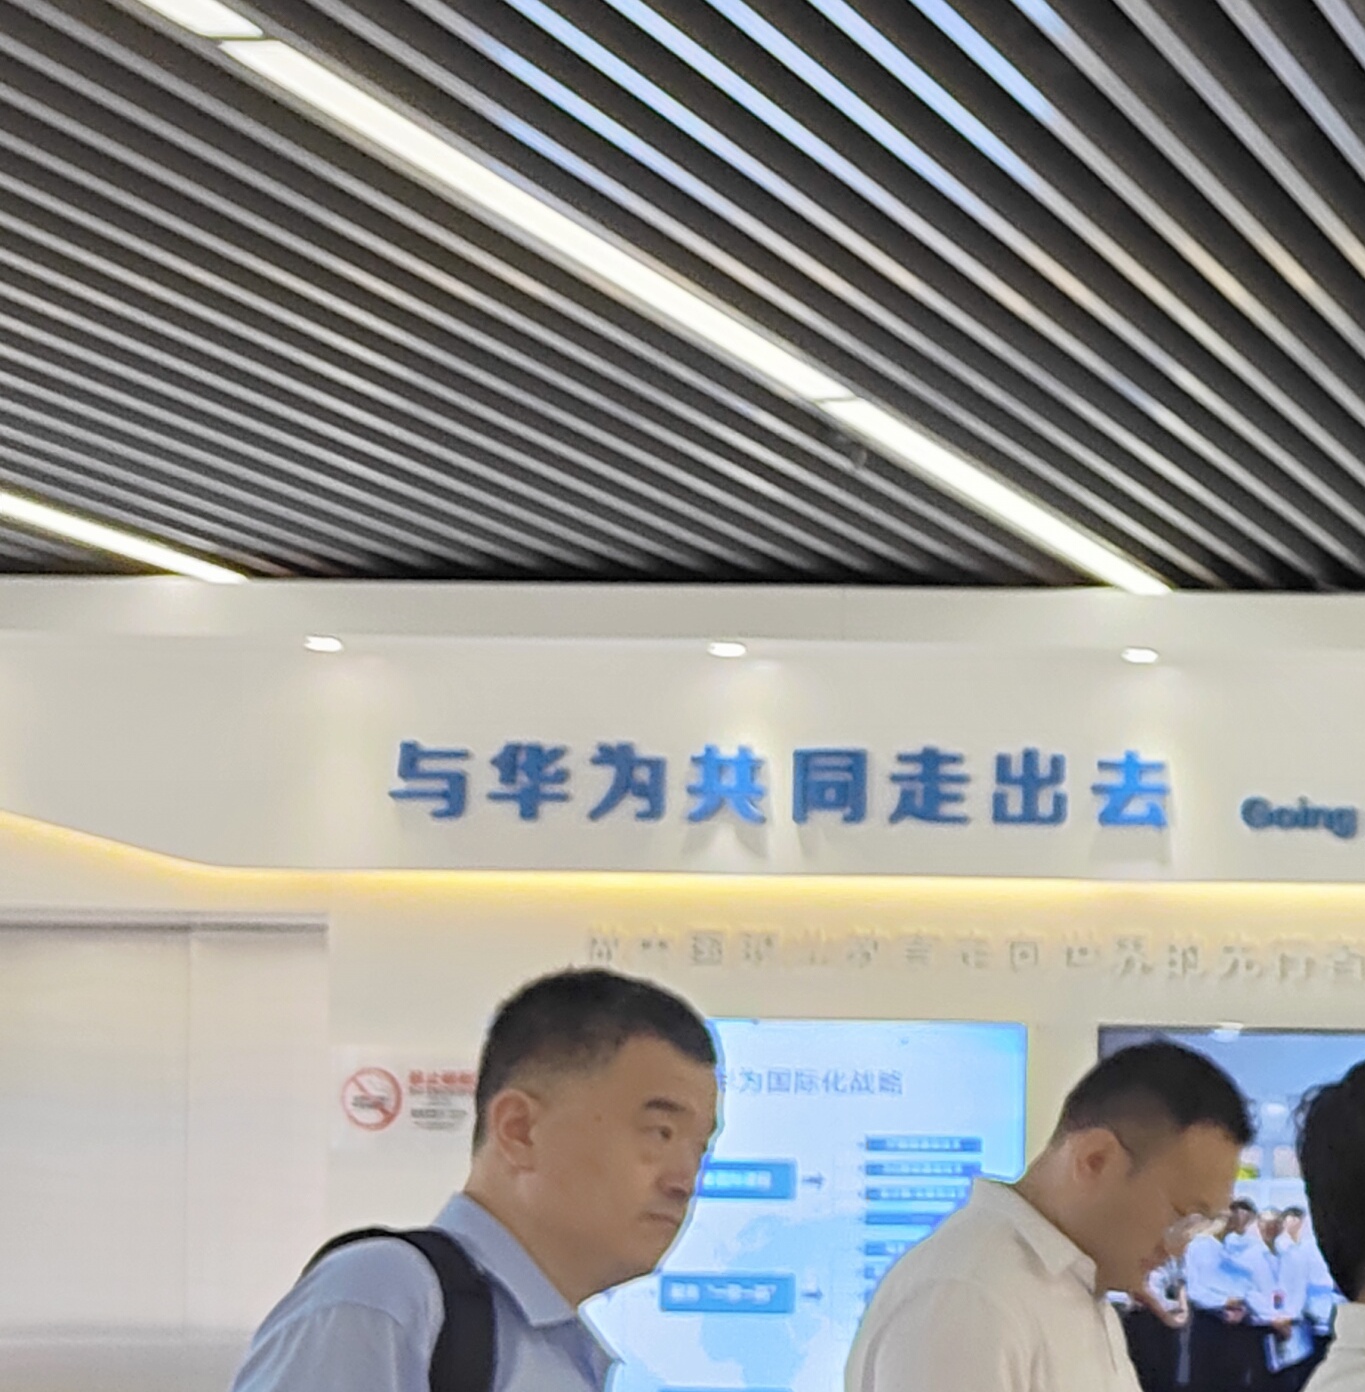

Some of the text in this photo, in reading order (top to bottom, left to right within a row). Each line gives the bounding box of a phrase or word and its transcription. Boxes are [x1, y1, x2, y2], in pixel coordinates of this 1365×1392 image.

[389, 740, 1172, 830] 与华为共同走出去
[1240, 796, 1357, 840] Going
